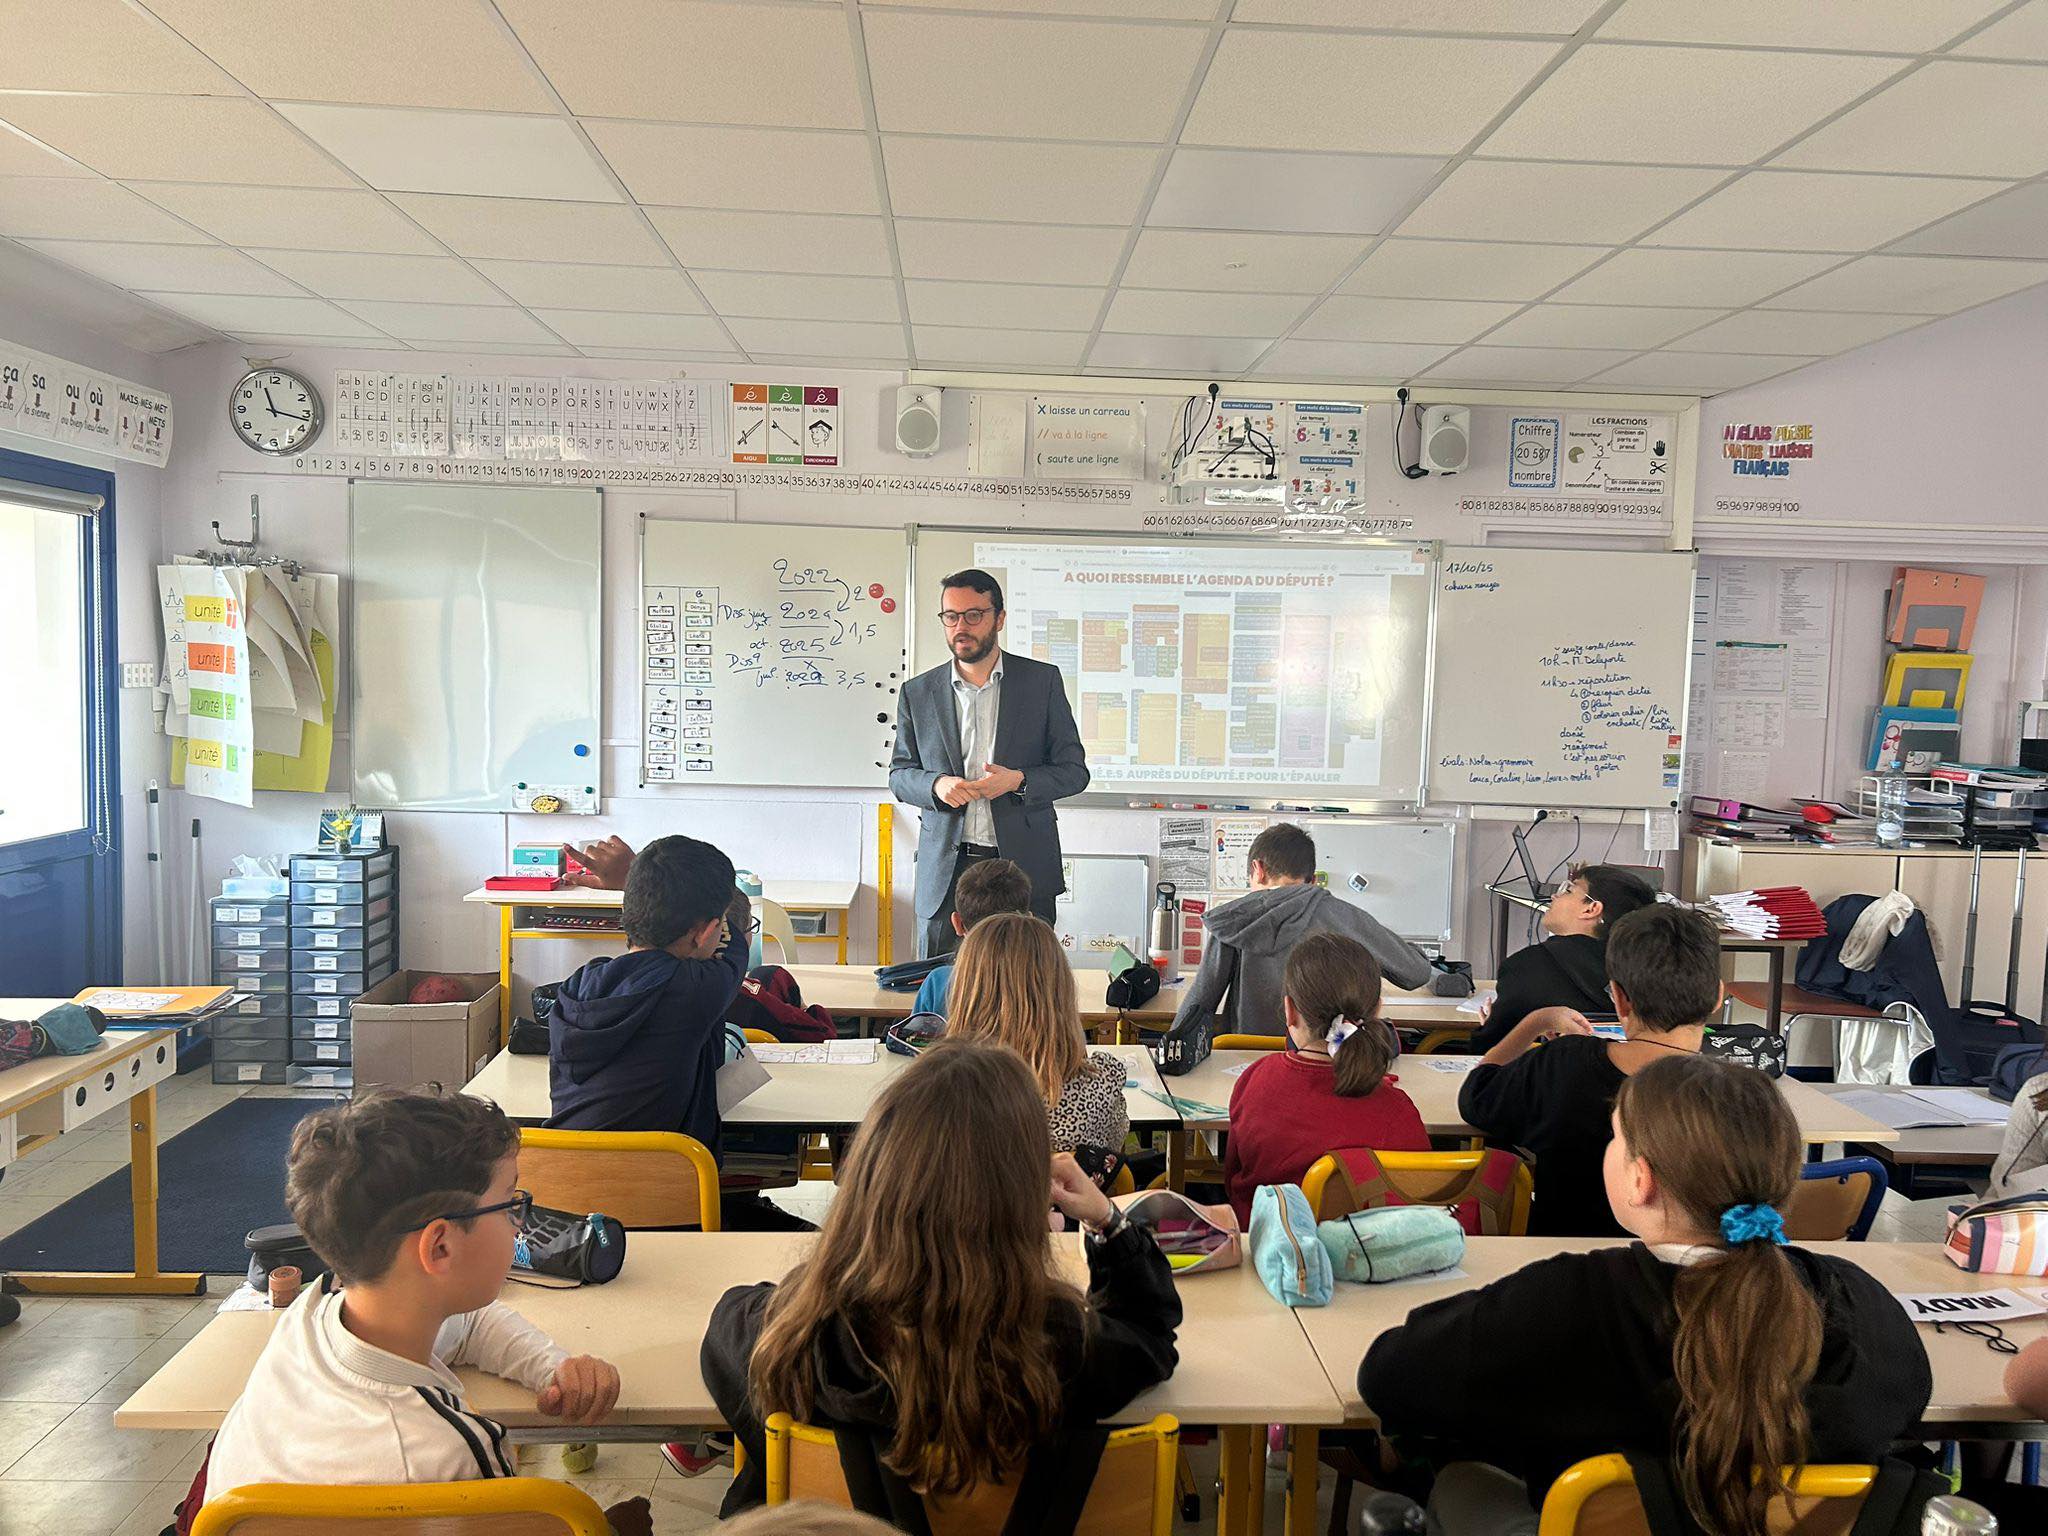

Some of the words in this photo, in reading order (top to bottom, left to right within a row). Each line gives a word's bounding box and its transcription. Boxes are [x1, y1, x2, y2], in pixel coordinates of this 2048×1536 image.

[3, 366, 18, 383] ça
[270, 376, 280, 384] 12
[32, 374, 45, 389] sa
[255, 380, 261, 388] 11
[290, 381, 292, 389] 1
[66, 384, 79, 399] ou
[90, 387, 103, 406] où
[744, 386, 757, 400] é
[779, 387, 792, 401] è
[814, 389, 828, 403] ê
[120, 392, 138, 405] MAIS
[154, 403, 168, 414] MET
[298, 394, 306, 402] 2
[302, 410, 310, 418] 3
[1038, 405, 1046, 414] X
[1050, 405, 1075, 415] laisse
[1093, 408, 1130, 416] carreau
[243, 421, 252, 429] 8
[1216, 415, 1223, 429] 3
[1267, 415, 1274, 431] 5
[1607, 418, 1647, 426] FRACTIONS
[1065, 430, 1071, 439] à
[1074, 430, 1082, 439] la
[1086, 430, 1108, 442] ligne
[1297, 427, 1306, 442] 6
[1320, 427, 1330, 442] 4
[1348, 430, 1357, 442] 2
[1519, 425, 1551, 436] Chiffre
[1724, 425, 1772, 440] ANGLAIS
[1517, 448, 1529, 458] 20
[1533, 448, 1550, 460] 587
[1597, 446, 1604, 457] 3
[1769, 442, 1812, 458] LIAISON
[1048, 455, 1074, 464] saute
[1077, 456, 1094, 464] une
[1097, 455, 1119, 465] ligne
[1594, 460, 1602, 471] 4
[441, 464, 451, 474] 10
[524, 467, 535, 476] 16
[567, 468, 577, 478] 19
[1733, 460, 1790, 477] FRANÇAIS
[651, 471, 663, 481] 25
[693, 472, 705, 482] 28
[1514, 471, 1550, 481] nombre
[819, 478, 831, 488] 37
[862, 479, 873, 488] 40
[944, 481, 955, 492] 46
[1345, 480, 1356, 494] 4
[1065, 488, 1076, 497] 55
[1105, 489, 1117, 499] 58
[1462, 501, 1474, 510] 80
[1543, 503, 1555, 512] 86
[1650, 506, 1662, 515] 94
[1783, 502, 1799, 511] 100
[1237, 517, 1250, 526] 67
[773, 558, 837, 585] 2022
[1446, 562, 1493, 574] 17/10/25
[1064, 573, 1074, 582] A
[1076, 572, 1110, 583] QUOI
[1112, 574, 1184, 585] RESSEMBLE
[1186, 574, 1251, 586] L'AGENDA
[1254, 576, 1274, 586] DU
[1276, 573, 1325, 587] DÉPUTÉ
[1326, 576, 1334, 587] ?
[194, 604, 221, 618] unité
[849, 622, 876, 644] 1,5
[750, 638, 773, 649] oct.
[780, 638, 825, 653] 2025
[197, 653, 220, 666] unité
[1541, 654, 1560, 666] 10h
[836, 670, 866, 689] 3,5
[1541, 676, 1567, 687] 11h30
[1578, 674, 1632, 689] répartition
[1628, 687, 1651, 695] dictée
[197, 700, 220, 713] unité
[1560, 729, 1585, 738] danse
[1562, 741, 1608, 752] rangement
[194, 747, 218, 762] unité
[1584, 754, 1598, 763] pas
[1500, 756, 1533, 772] grammaire
[1127, 769, 1172, 779] AUPRÈS
[1174, 771, 1189, 780] DU
[1191, 769, 1246, 781] DÉPUTÉ.E
[1247, 772, 1279, 781] POUR
[1281, 771, 1341, 783] L'ÉPAULER
[1061, 937, 1071, 947] 16
[599, 1230, 607, 1244] OM
[1910, 1296, 2011, 1314] MADY
